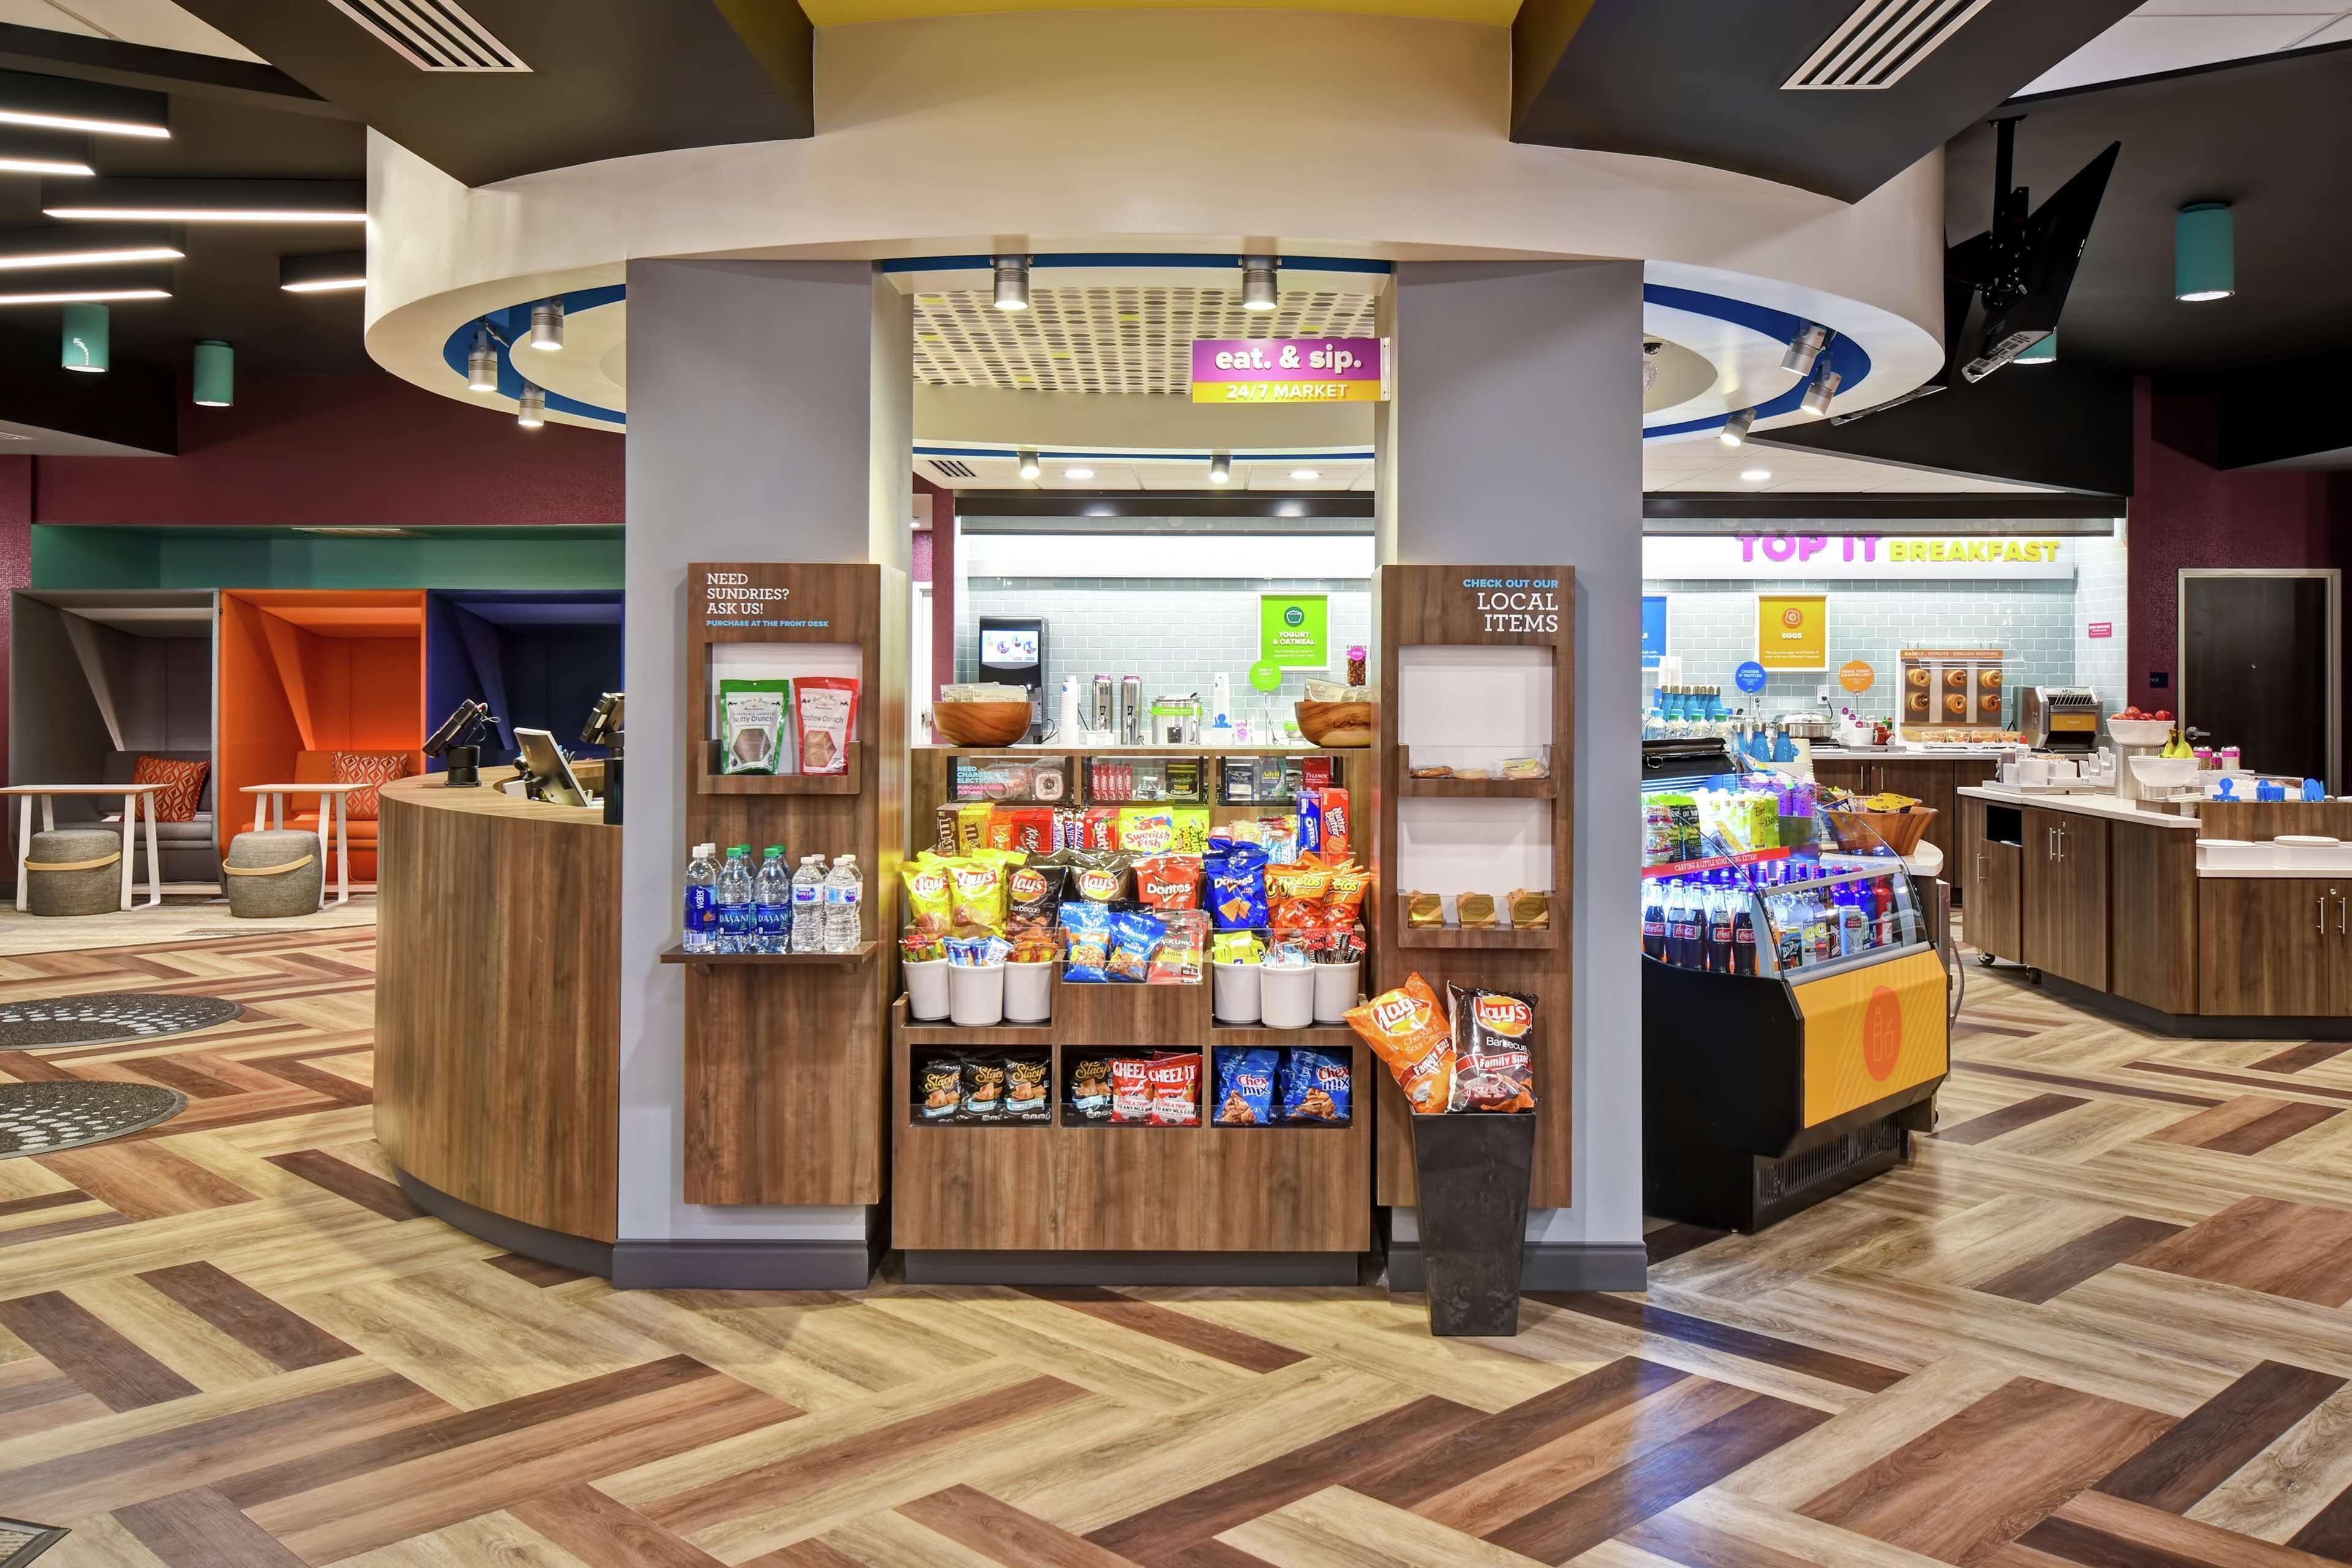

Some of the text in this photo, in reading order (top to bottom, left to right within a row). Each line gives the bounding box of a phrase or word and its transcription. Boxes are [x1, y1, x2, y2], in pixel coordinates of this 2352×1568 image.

[1215, 344, 1362, 374] eat. & sip.
[1227, 384, 1348, 399] 24/7 MARKET
[1735, 536, 2060, 562] TOP IT BREAKFAST
[706, 573, 748, 584] NEED
[1463, 579, 1559, 588] CHECK OUT OUR
[706, 588, 790, 600] SUNDRIES?
[1477, 592, 1559, 611] LOCAL
[706, 603, 763, 614] ASK US!
[1485, 614, 1559, 632] ITEMS
[1325, 812, 1340, 837] Butter
[1332, 806, 1346, 834] Nutter
[1125, 831, 1170, 844] Swedish
[1190, 827, 1199, 852] SOUR
[1305, 817, 1316, 847] OREO
[1137, 839, 1161, 848] Fish
[1146, 883, 1191, 895] Doritos
[1009, 903, 1041, 914] Barbecue
[720, 913, 748, 923] DASANI
[1479, 1003, 1527, 1023] Lay's
[1404, 1027, 1433, 1046] Cheddar
[1405, 1031, 1446, 1054] Sour Cream
[1487, 1036, 1527, 1052] Barbecue
[1414, 1052, 1438, 1077] Family
[1480, 1054, 1529, 1068] Family Size!
[1012, 1063, 1047, 1083] Stacy's
[1076, 1061, 1111, 1080] Stacy's
[1113, 1061, 1147, 1079] CHEEZ
[1319, 1065, 1349, 1080] Chex
[925, 1071, 960, 1091] Stacy's
[1237, 1074, 1268, 1086] Chex
[1322, 1079, 1350, 1091] mix
[1243, 1085, 1269, 1096] mix
